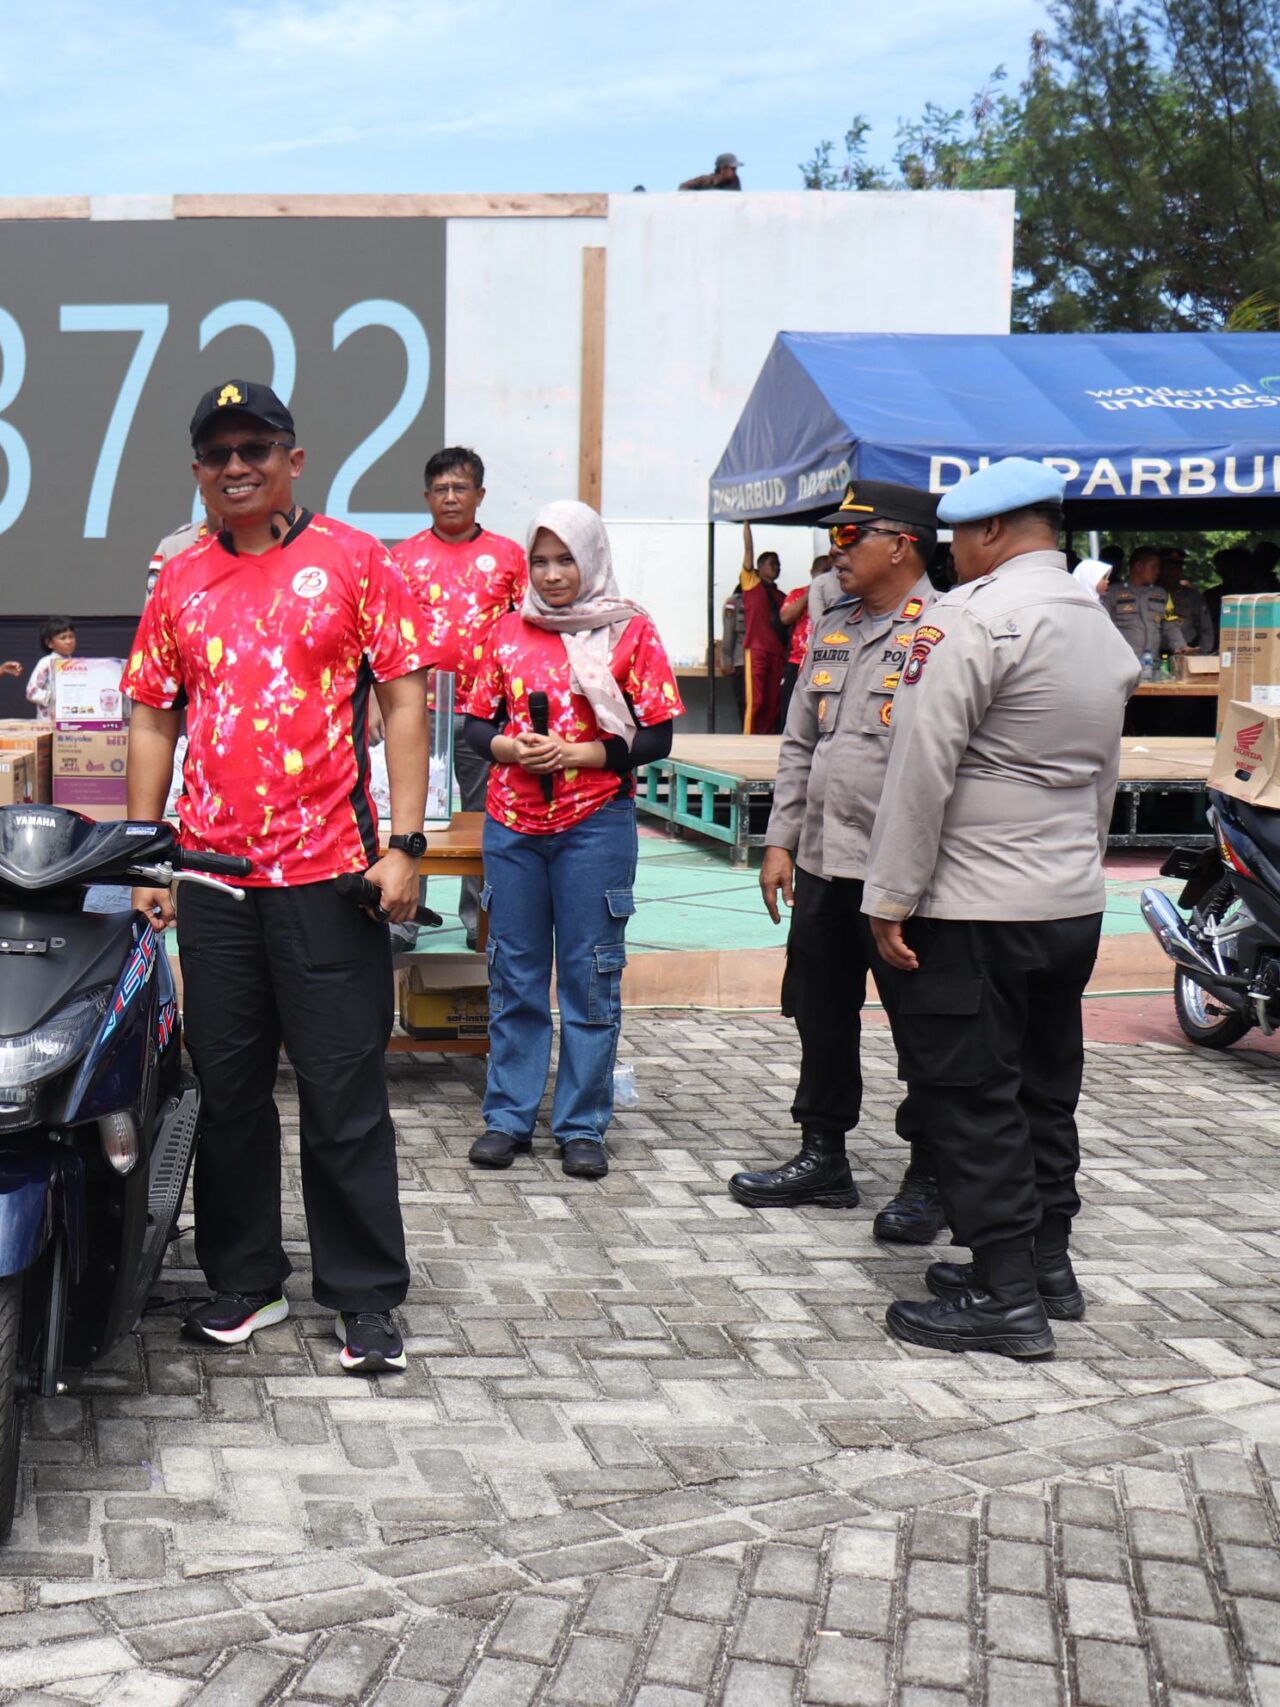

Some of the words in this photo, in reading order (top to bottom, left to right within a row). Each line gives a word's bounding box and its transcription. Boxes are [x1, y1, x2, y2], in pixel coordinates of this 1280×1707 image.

[1084, 383, 1258, 399] wonderful
[1094, 395, 1280, 411] indones
[928, 456, 1280, 496] DPARBU
[1232, 745, 1263, 761] HONDA
[15, 815, 56, 828] YAMAHA
